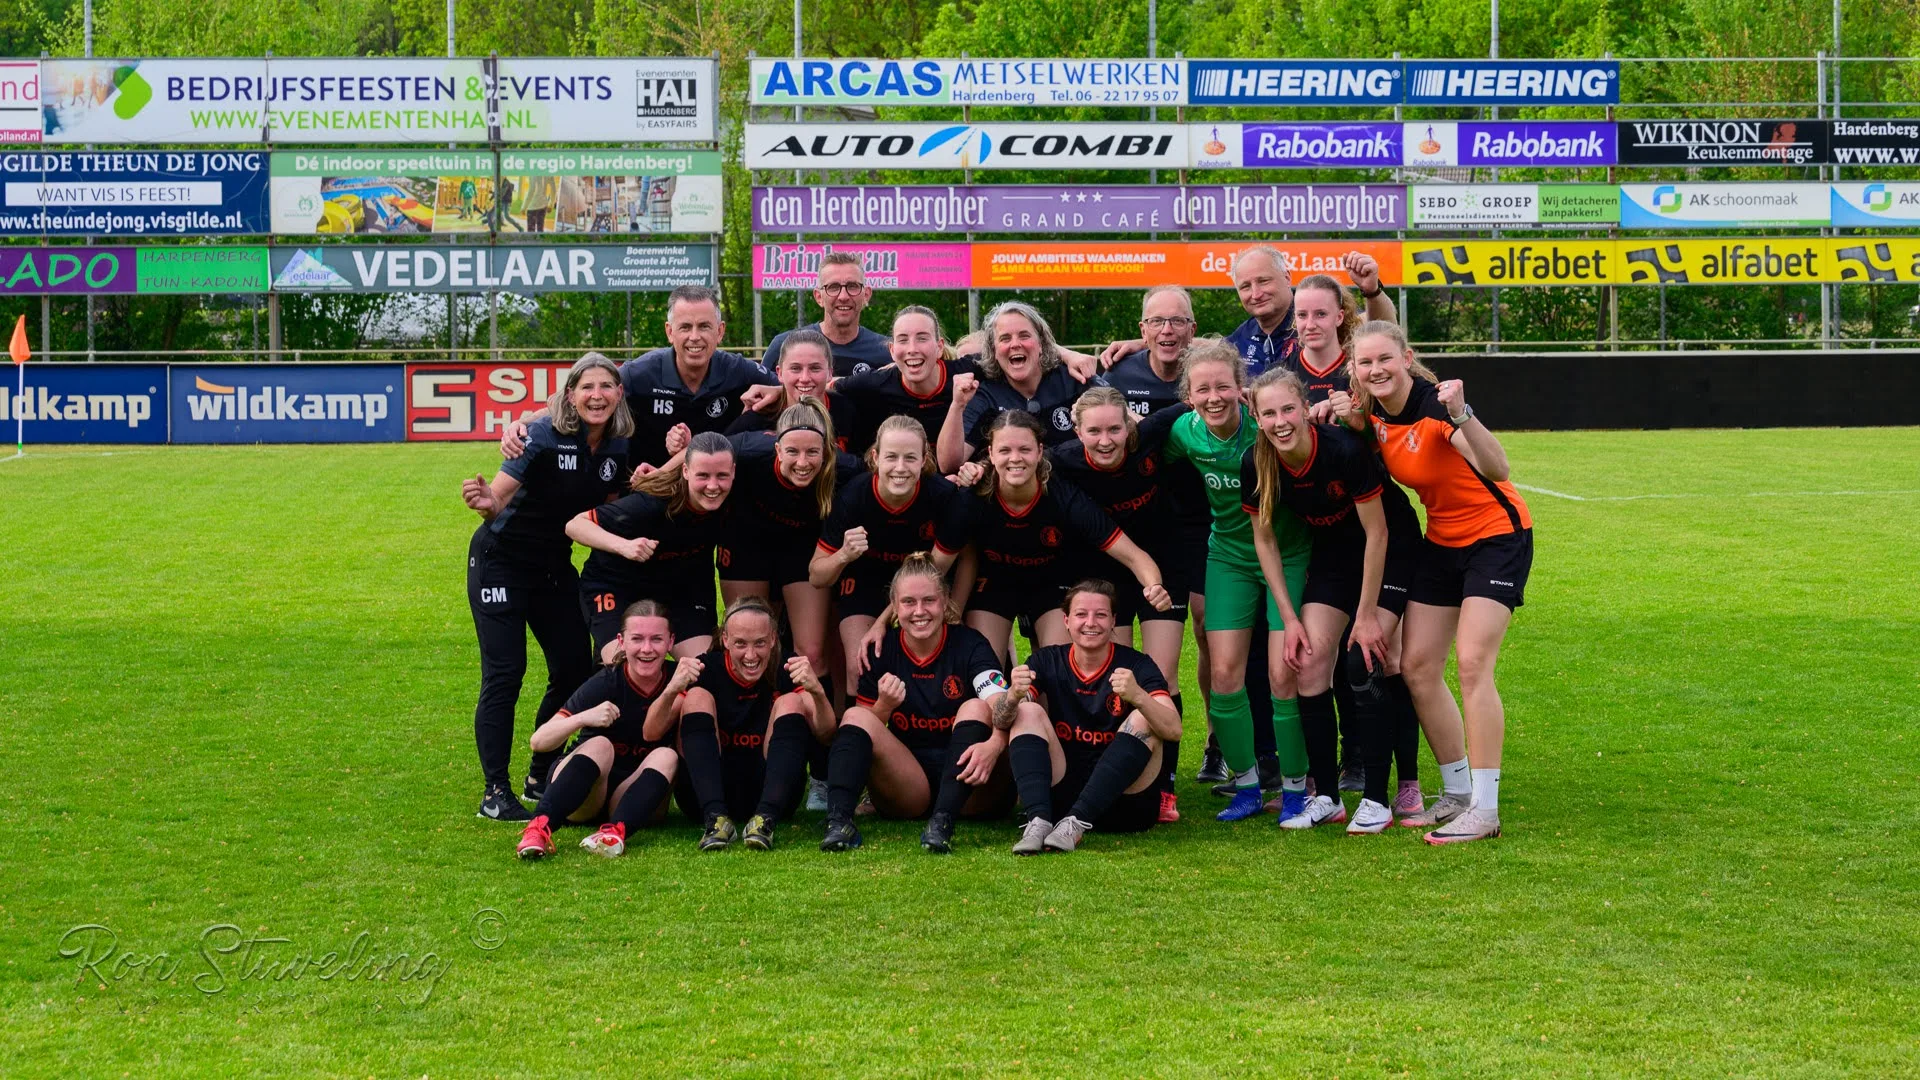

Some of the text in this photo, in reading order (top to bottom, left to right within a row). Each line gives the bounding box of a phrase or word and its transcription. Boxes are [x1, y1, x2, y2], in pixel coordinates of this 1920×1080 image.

[636, 70, 697, 78] Evenementen
[763, 61, 943, 97] ARCAS
[953, 62, 1180, 85] METSELWERKEN
[167, 76, 612, 101] BEDRIJFSFEESTEN & EVENTS
[637, 79, 696, 106] HAL
[953, 89, 1035, 104] Hardenberg
[1051, 90, 1073, 102] Tel.
[1075, 90, 1092, 102] 06
[1104, 90, 1120, 102] 22
[1124, 90, 1140, 102] 17
[1143, 90, 1159, 102] 95
[1162, 90, 1179, 102] 07
[190, 110, 537, 129] WWW.EVENEMENTENHA.NL
[644, 107, 697, 116] HARDENBERG
[648, 120, 697, 128] EASYFAIRS
[1633, 122, 1762, 144] WIKINON
[1833, 121, 1919, 138] Hardenberg
[762, 135, 1173, 157] AUTO COMBI
[1257, 130, 1392, 160] Rabobank
[1472, 130, 1604, 159] Rabobank
[295, 153, 693, 174] Dé indoor speeltuin in de regio Hardenberg!
[1197, 158, 1232, 168] Rabobank
[1412, 158, 1448, 167] Rabobank
[1687, 145, 1814, 164] Keukenmontage
[78, 153, 159, 172] THEUN
[165, 153, 196, 172] DE
[202, 153, 261, 176] JONG
[37, 187, 191, 202] WANT VIS IS FEEST!
[1419, 197, 1532, 208] SEBO GROEP
[1542, 196, 1618, 208] Wij detacheren
[1689, 192, 1799, 206] AK schoonmaak
[1899, 192, 1919, 204] AK
[760, 187, 989, 231] den Herdenbergher
[1173, 186, 1399, 230] den Herdenbergher
[1542, 208, 1603, 219] aanpakkers!
[1002, 208, 1160, 228] GRAND CAFÉ
[143, 250, 262, 263] HARDENBERG
[626, 246, 687, 255] Boerenwinkel
[762, 244, 898, 274] Brinan
[991, 253, 1166, 264] JOUW AMBITIES WAARMAKEN
[0, 251, 120, 288] ADO
[351, 250, 596, 287] VEDELAAR
[623, 257, 690, 265] Groente & Fruit
[991, 264, 1145, 273] SAMEN GAAN WE ERVOOR!
[1200, 251, 1227, 272] de
[1489, 247, 1607, 280] alfabet
[1701, 245, 1818, 278] alfabet
[602, 267, 710, 277] Consumptieaardappelen
[607, 277, 652, 286] Tuinaarde
[653, 399, 674, 415] HS
[558, 453, 577, 470] CM
[481, 587, 507, 603] CM
[840, 577, 857, 596] 10
[593, 593, 616, 613] 16
